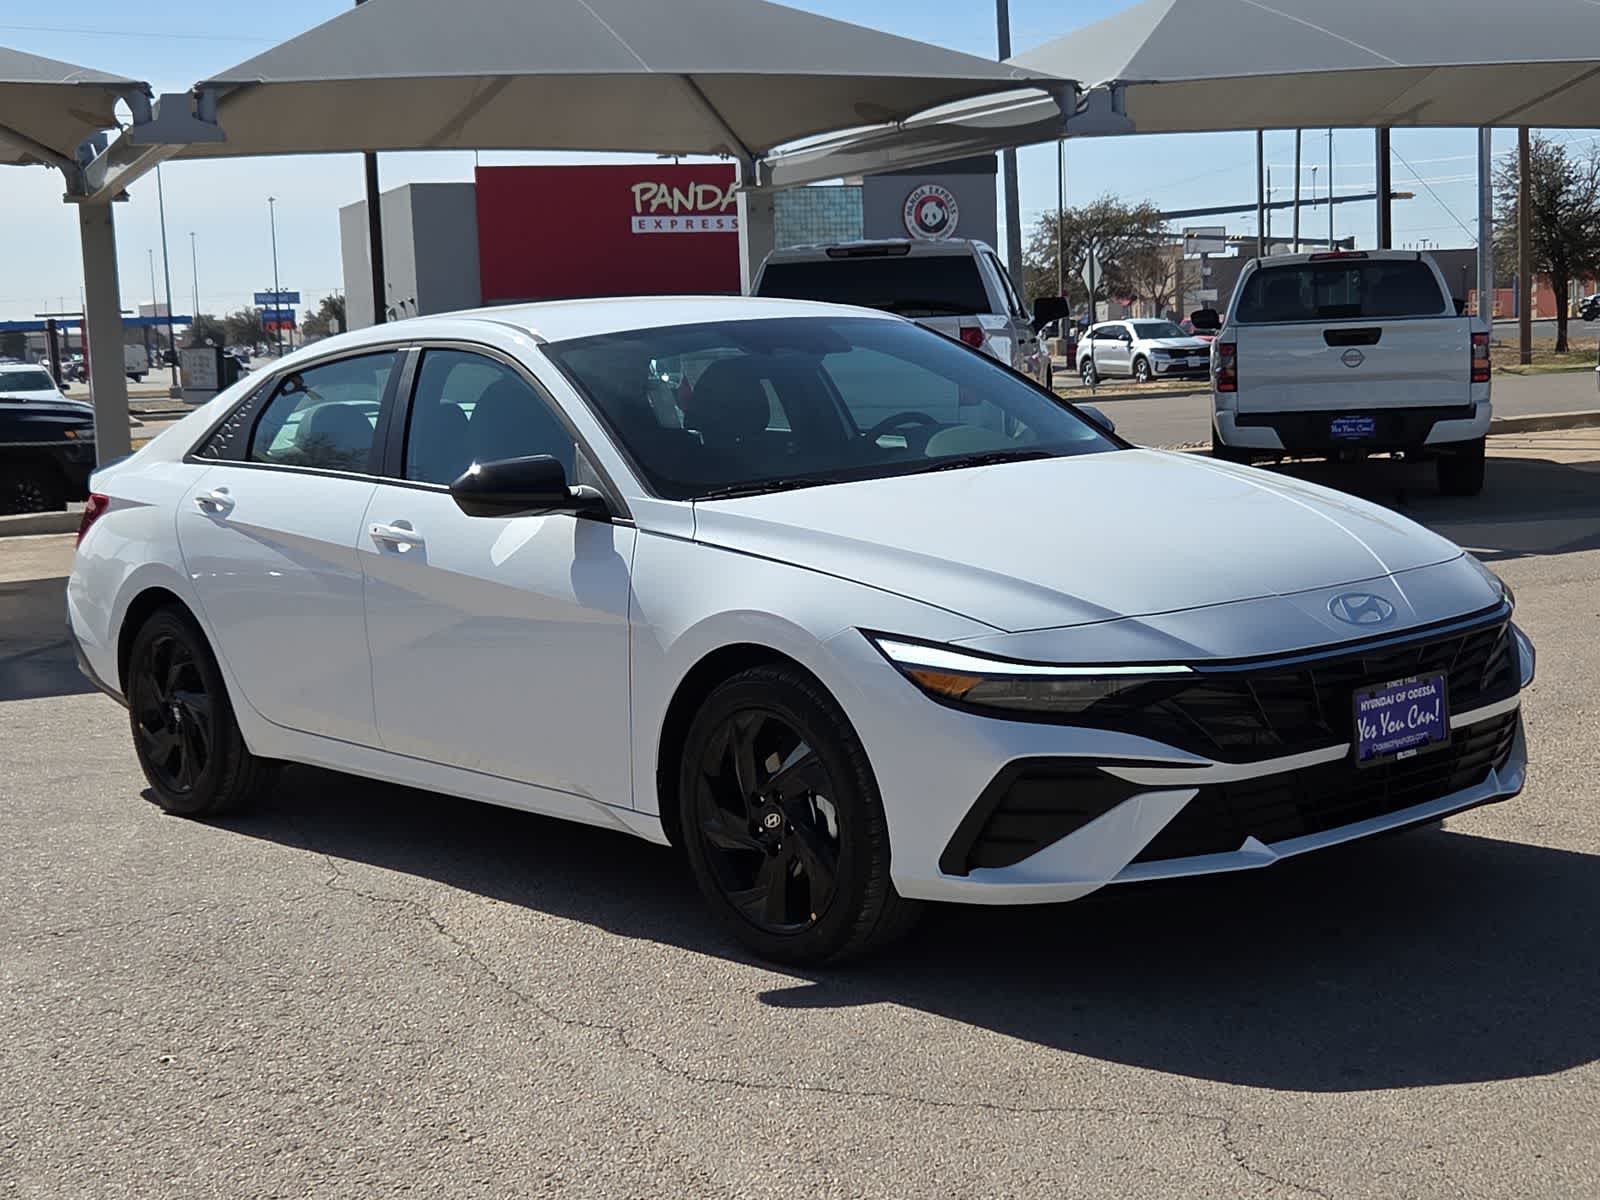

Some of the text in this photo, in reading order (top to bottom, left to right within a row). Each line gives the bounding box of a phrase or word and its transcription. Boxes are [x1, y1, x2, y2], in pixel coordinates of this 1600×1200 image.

[630, 181, 738, 214] PANDA
[907, 188, 926, 217] PANDA
[638, 219, 738, 230] EXPRESS
[1361, 685, 1436, 712] HYUNDAI OF ODESSA
[1357, 698, 1440, 742] Yes You Can!
